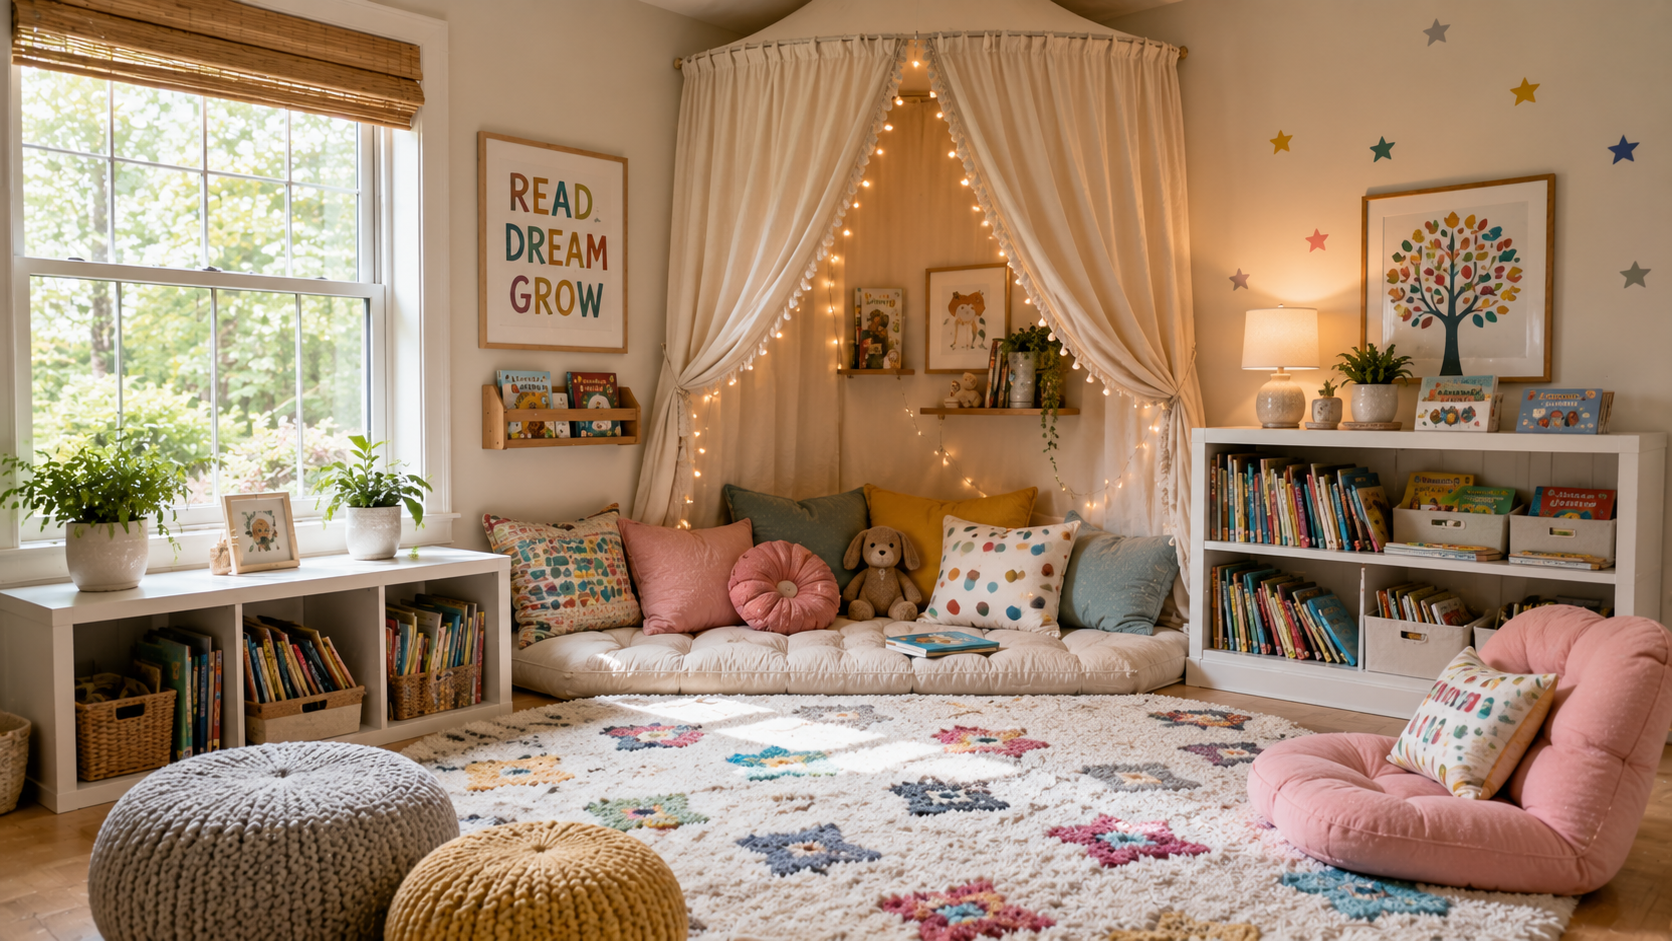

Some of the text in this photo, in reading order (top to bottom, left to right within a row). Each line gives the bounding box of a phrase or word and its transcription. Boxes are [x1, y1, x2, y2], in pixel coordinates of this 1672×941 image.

[510, 172, 593, 220] READ
[505, 222, 608, 271] DREAM
[510, 275, 604, 319] GROW
